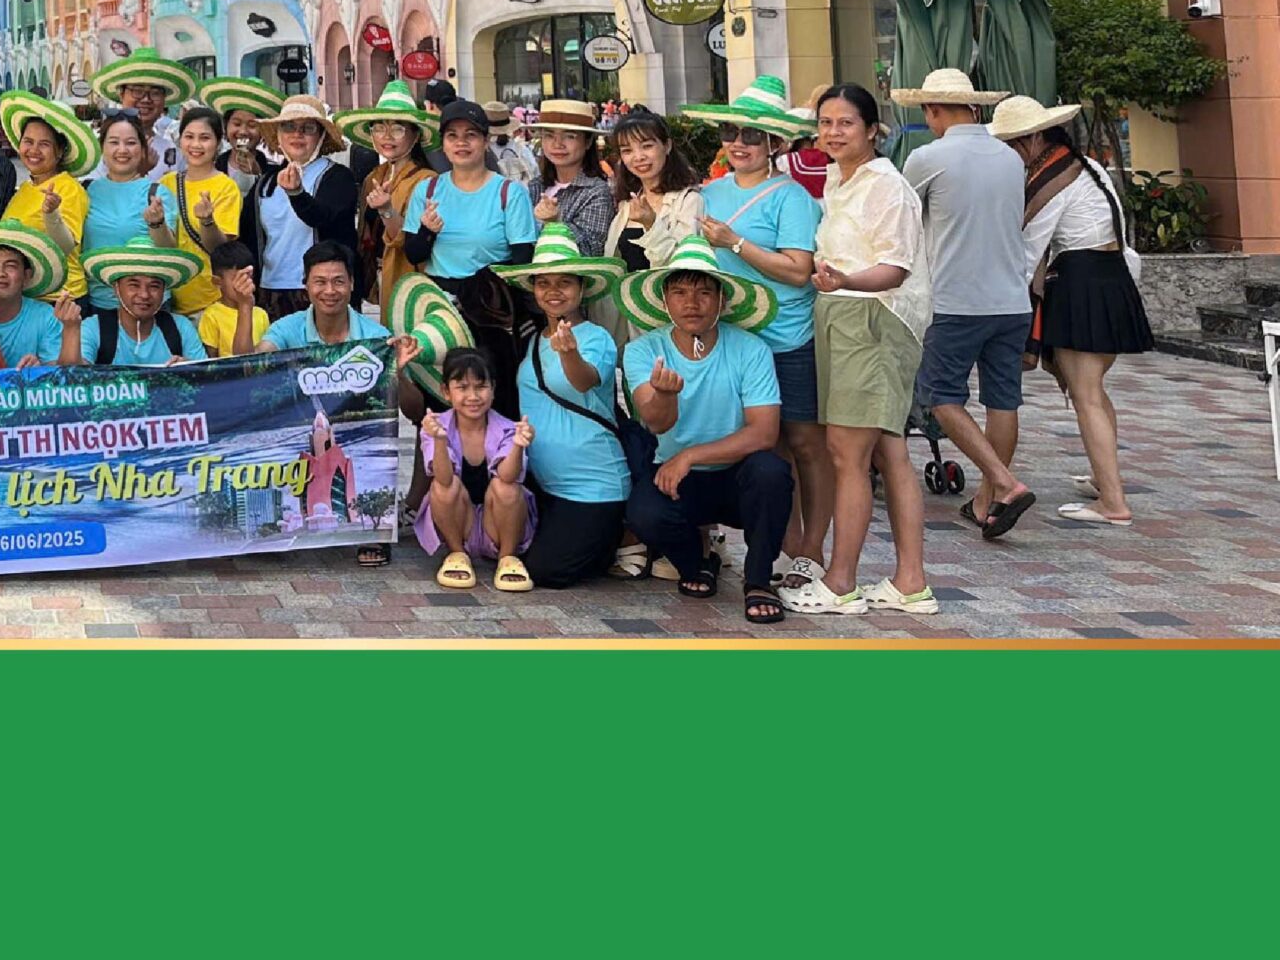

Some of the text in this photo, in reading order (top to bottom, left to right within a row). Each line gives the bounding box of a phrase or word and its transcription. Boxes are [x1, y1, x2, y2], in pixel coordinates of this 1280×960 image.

[26, 382, 88, 407] MỪNG
[92, 378, 146, 403] ĐOÀN
[17, 428, 54, 455] TH
[61, 421, 141, 455] NGỌK
[145, 416, 206, 445] TEM
[6, 468, 84, 518] lịch
[88, 462, 183, 502] Nha
[187, 456, 313, 497] Trang
